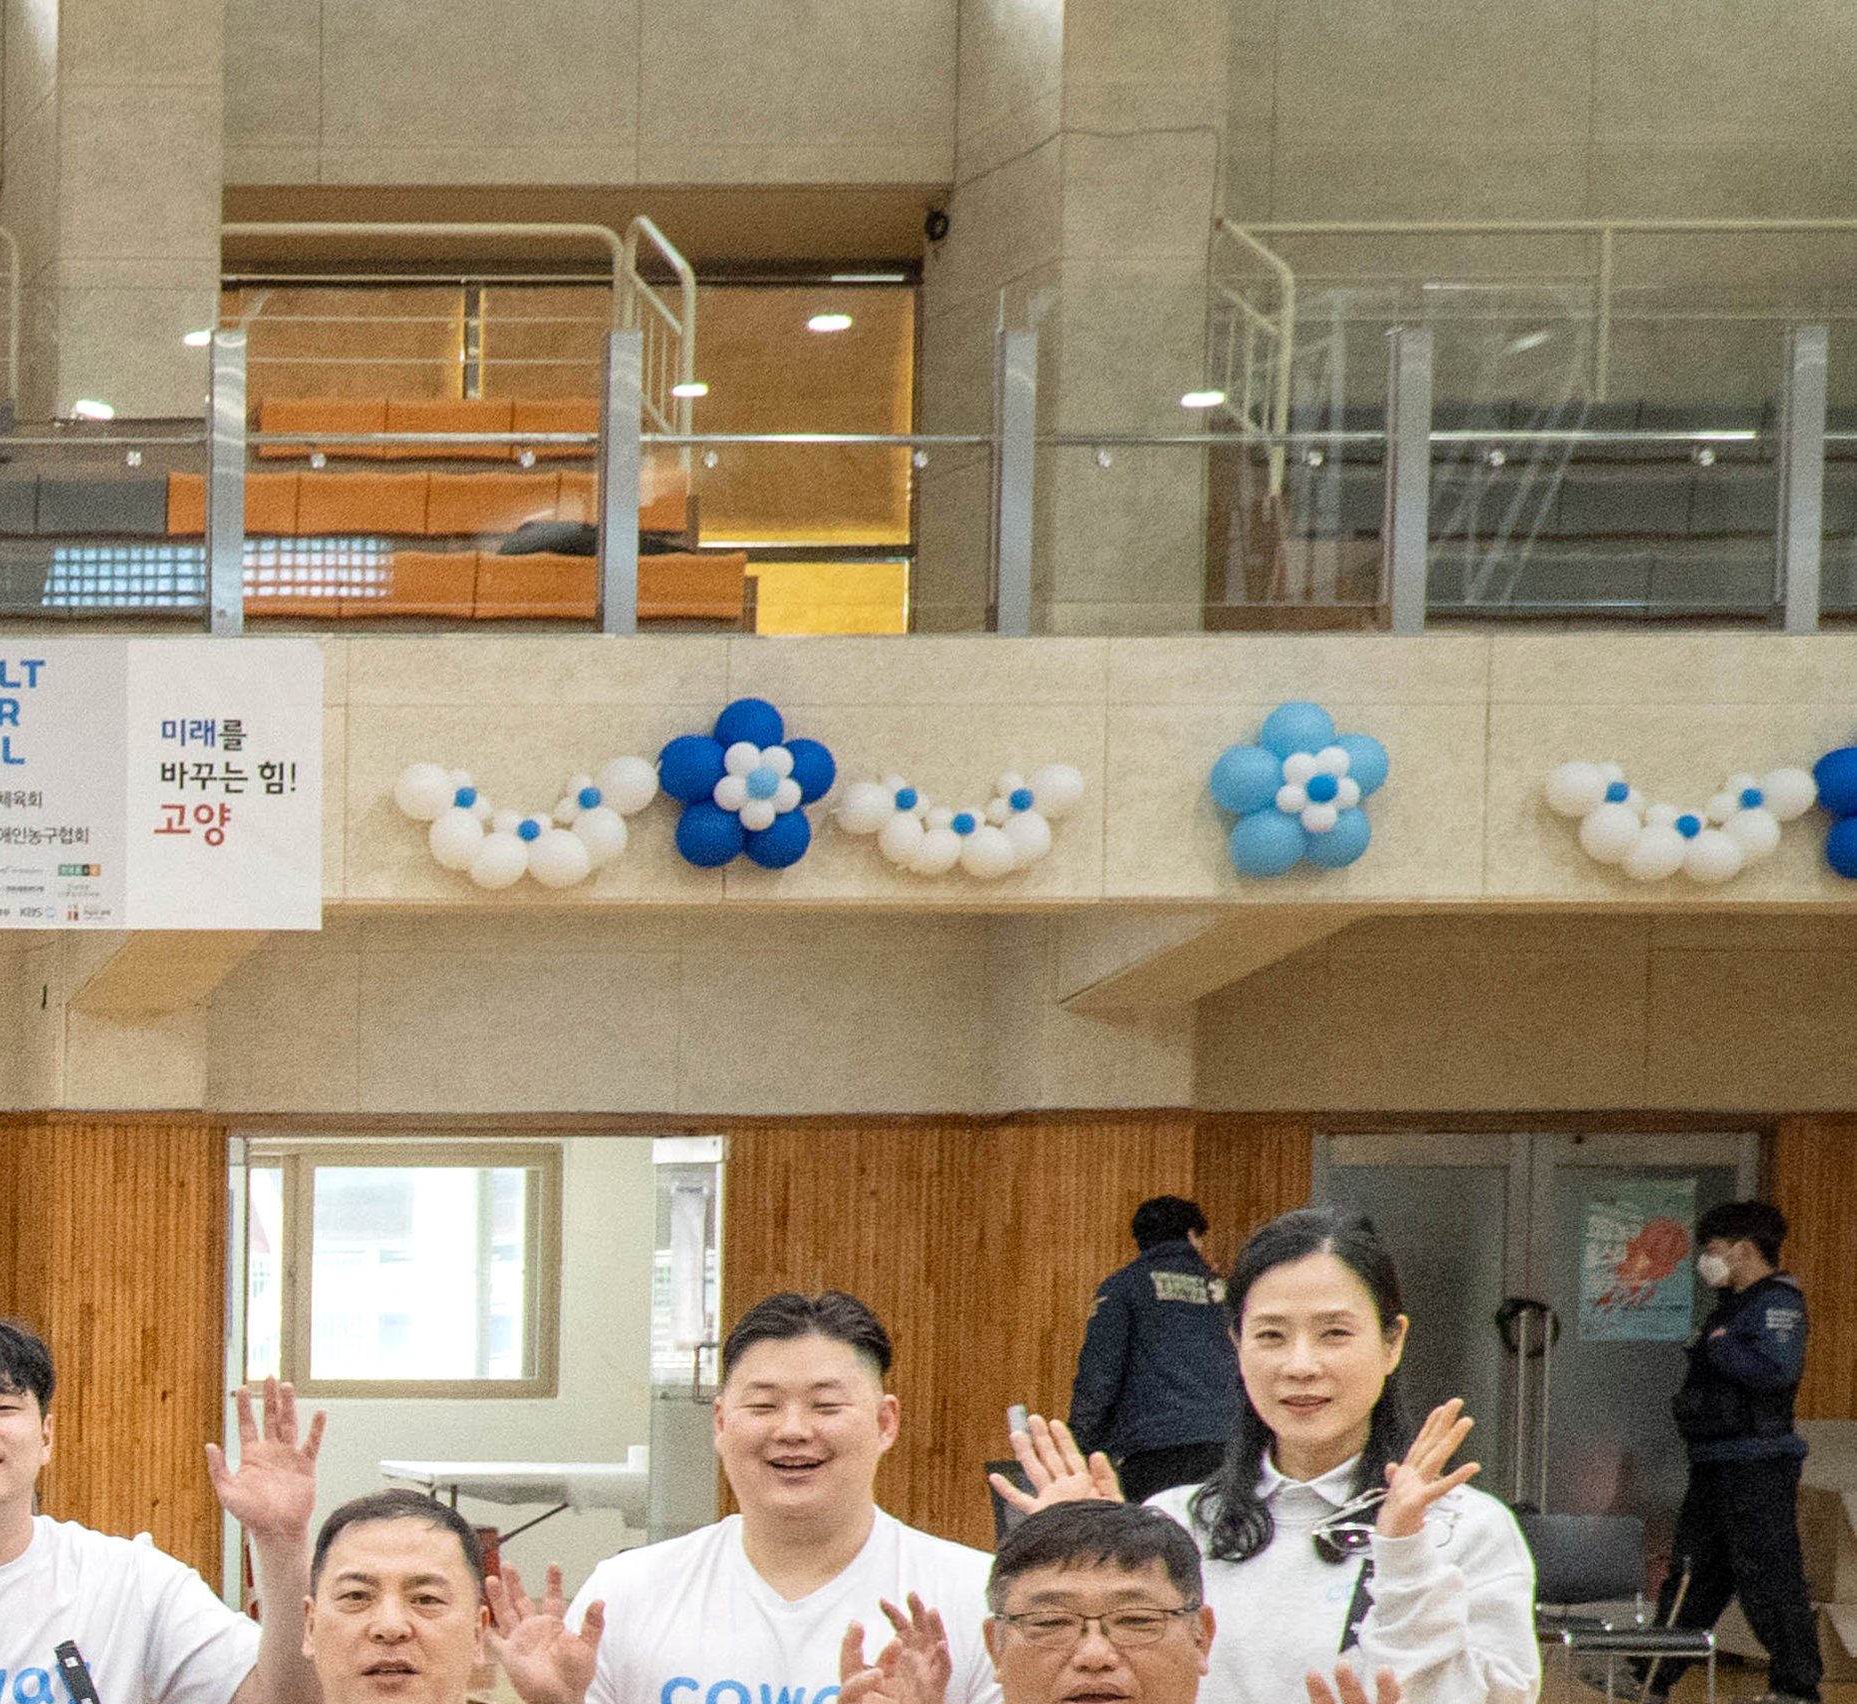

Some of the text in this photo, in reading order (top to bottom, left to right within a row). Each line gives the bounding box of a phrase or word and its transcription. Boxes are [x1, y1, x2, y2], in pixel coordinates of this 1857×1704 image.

[160, 719, 248, 752] 미래를
[160, 760, 297, 795] 바꾸는 힘!
[153, 802, 232, 847] 고양
